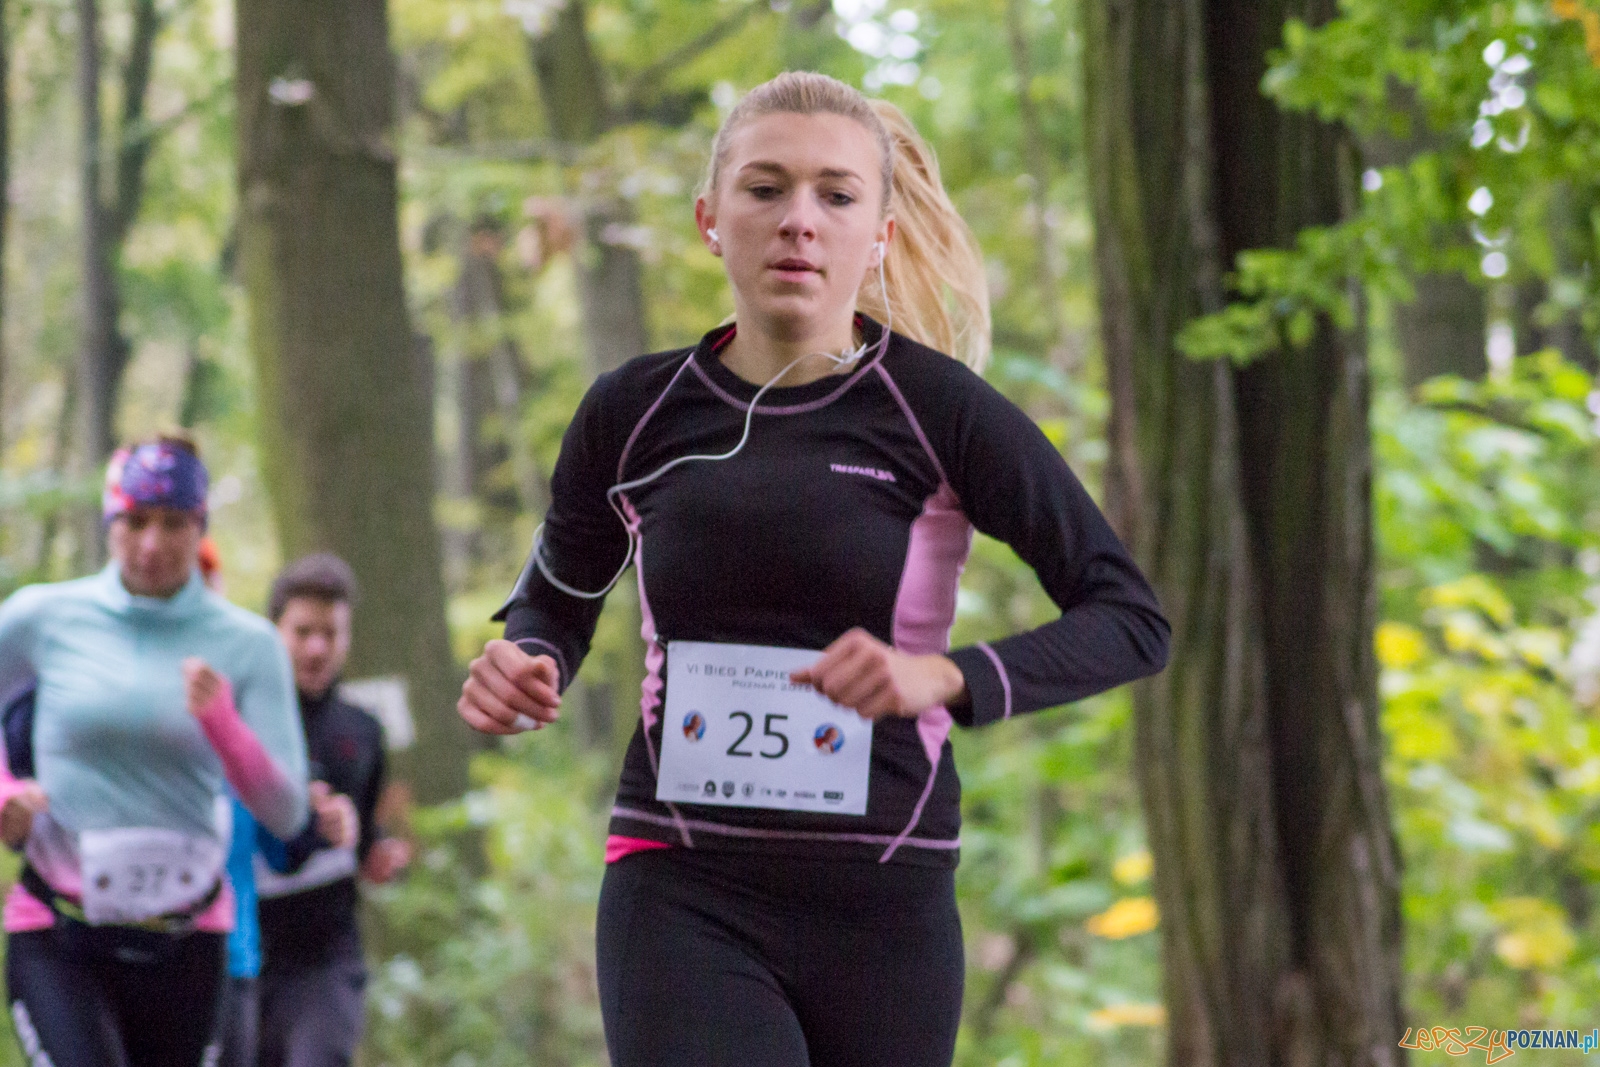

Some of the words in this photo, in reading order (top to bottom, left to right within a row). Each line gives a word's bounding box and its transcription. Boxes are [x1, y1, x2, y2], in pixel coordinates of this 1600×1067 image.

[686, 663, 699, 674] VI
[744, 665, 790, 681] PAPIE
[726, 710, 790, 760] 25
